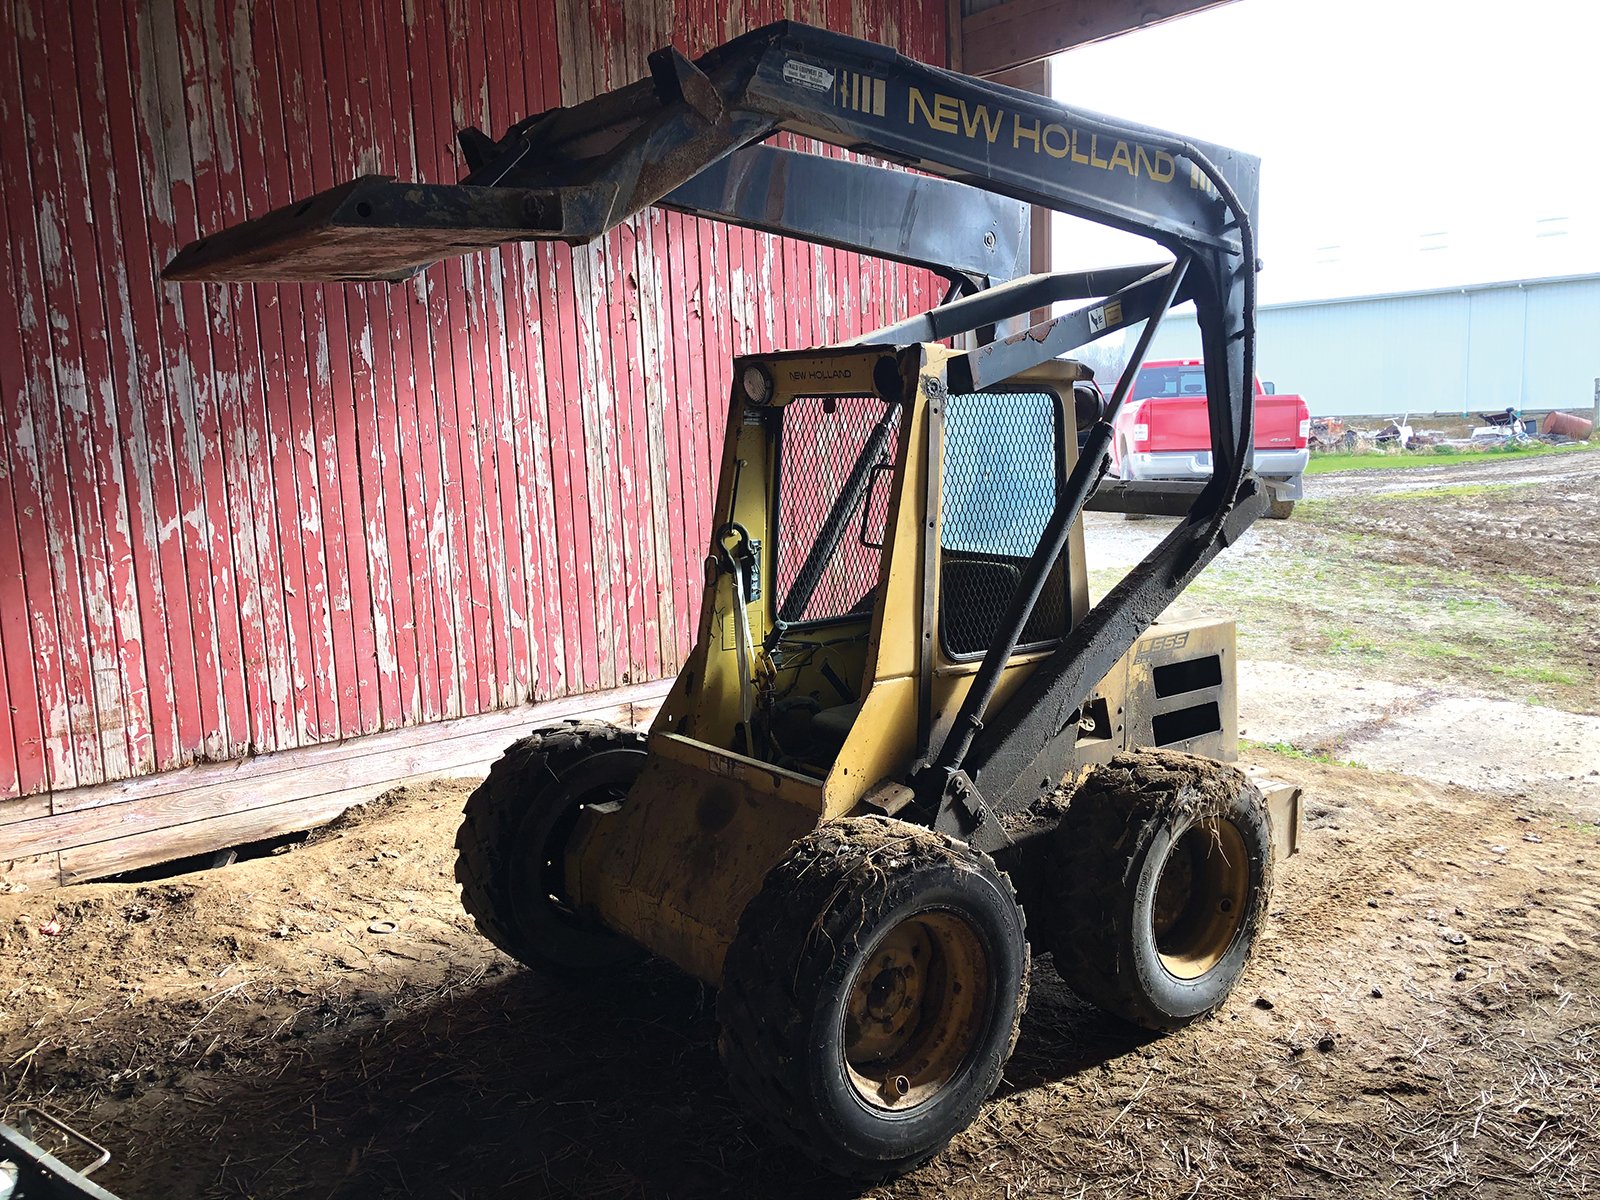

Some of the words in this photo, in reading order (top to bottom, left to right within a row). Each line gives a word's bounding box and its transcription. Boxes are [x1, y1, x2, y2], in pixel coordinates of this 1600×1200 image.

[908, 86, 1004, 143] NEW
[1013, 113, 1176, 183] HOLLAND
[789, 371, 806, 380] NEW
[808, 369, 852, 380] HOLLAND
